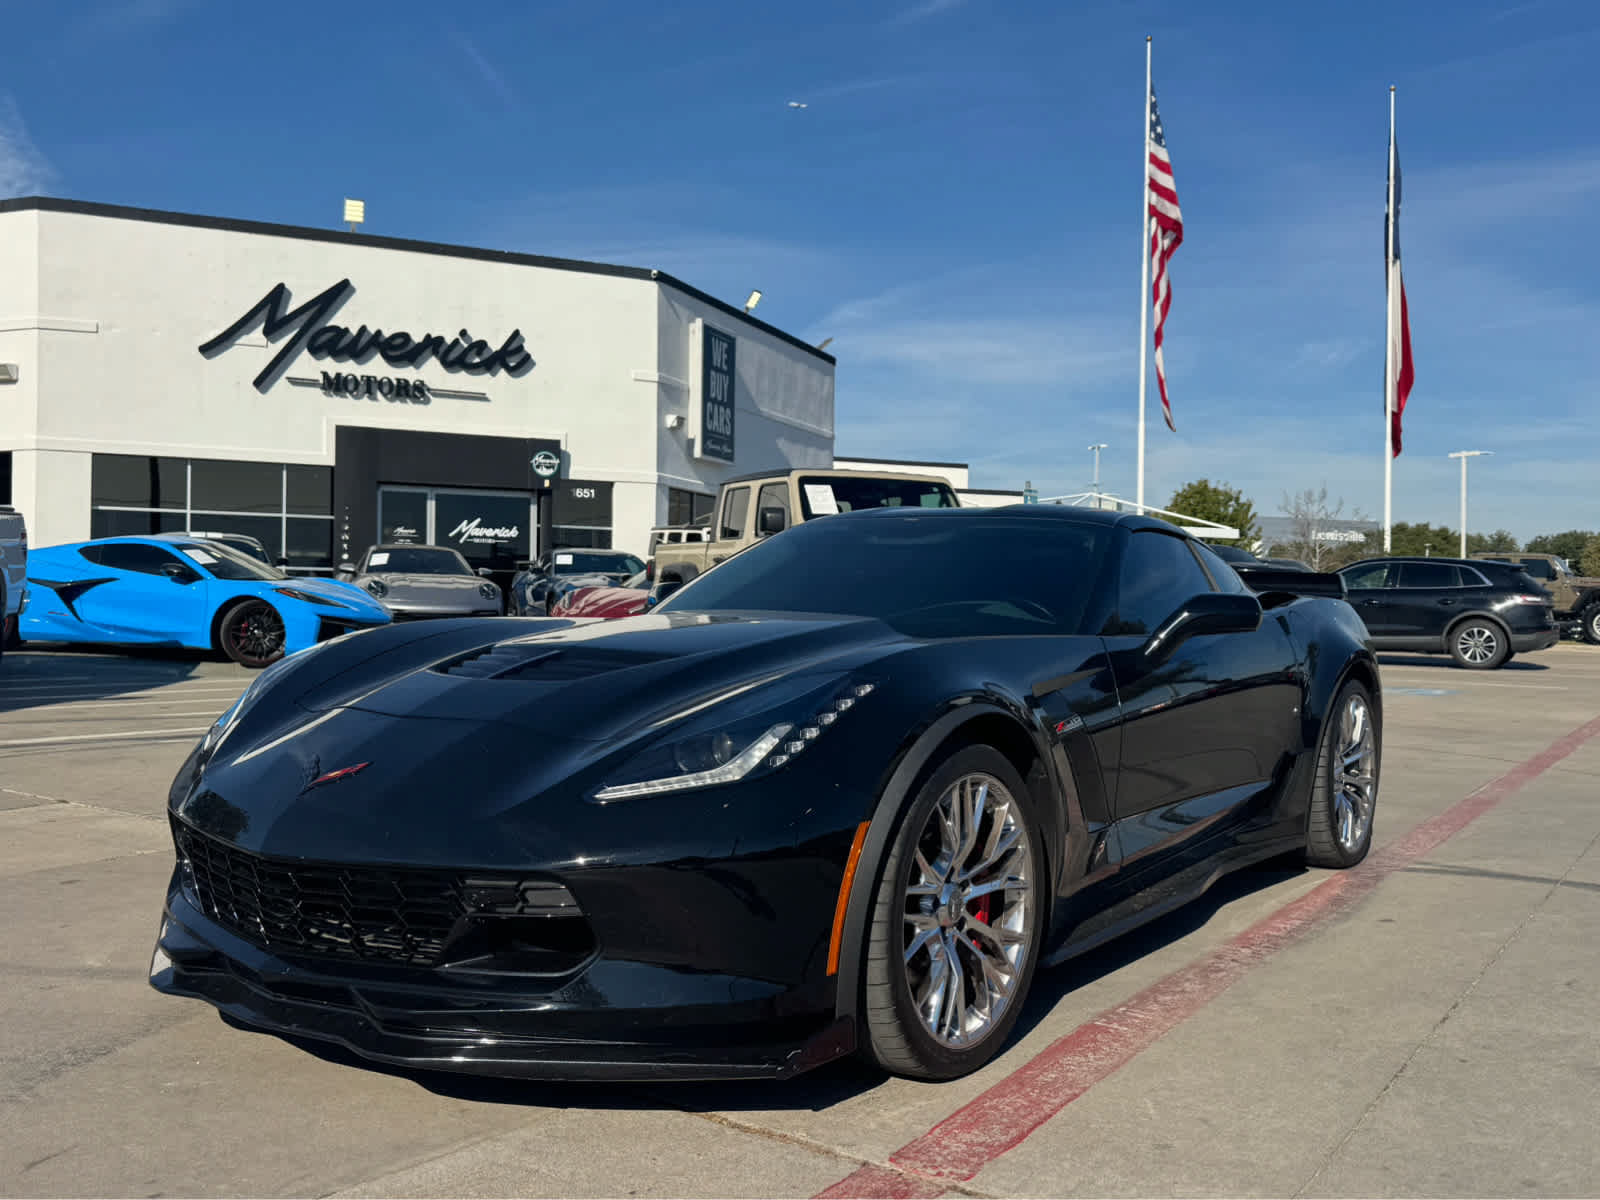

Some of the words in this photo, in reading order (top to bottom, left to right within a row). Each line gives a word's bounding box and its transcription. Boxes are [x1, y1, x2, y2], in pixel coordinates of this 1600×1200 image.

[198, 278, 535, 393] Maverick
[711, 336, 728, 371] WE
[320, 371, 430, 403] MOTORS
[710, 370, 729, 402] BUY
[706, 402, 732, 436] CARS
[448, 517, 520, 544] Maverick
